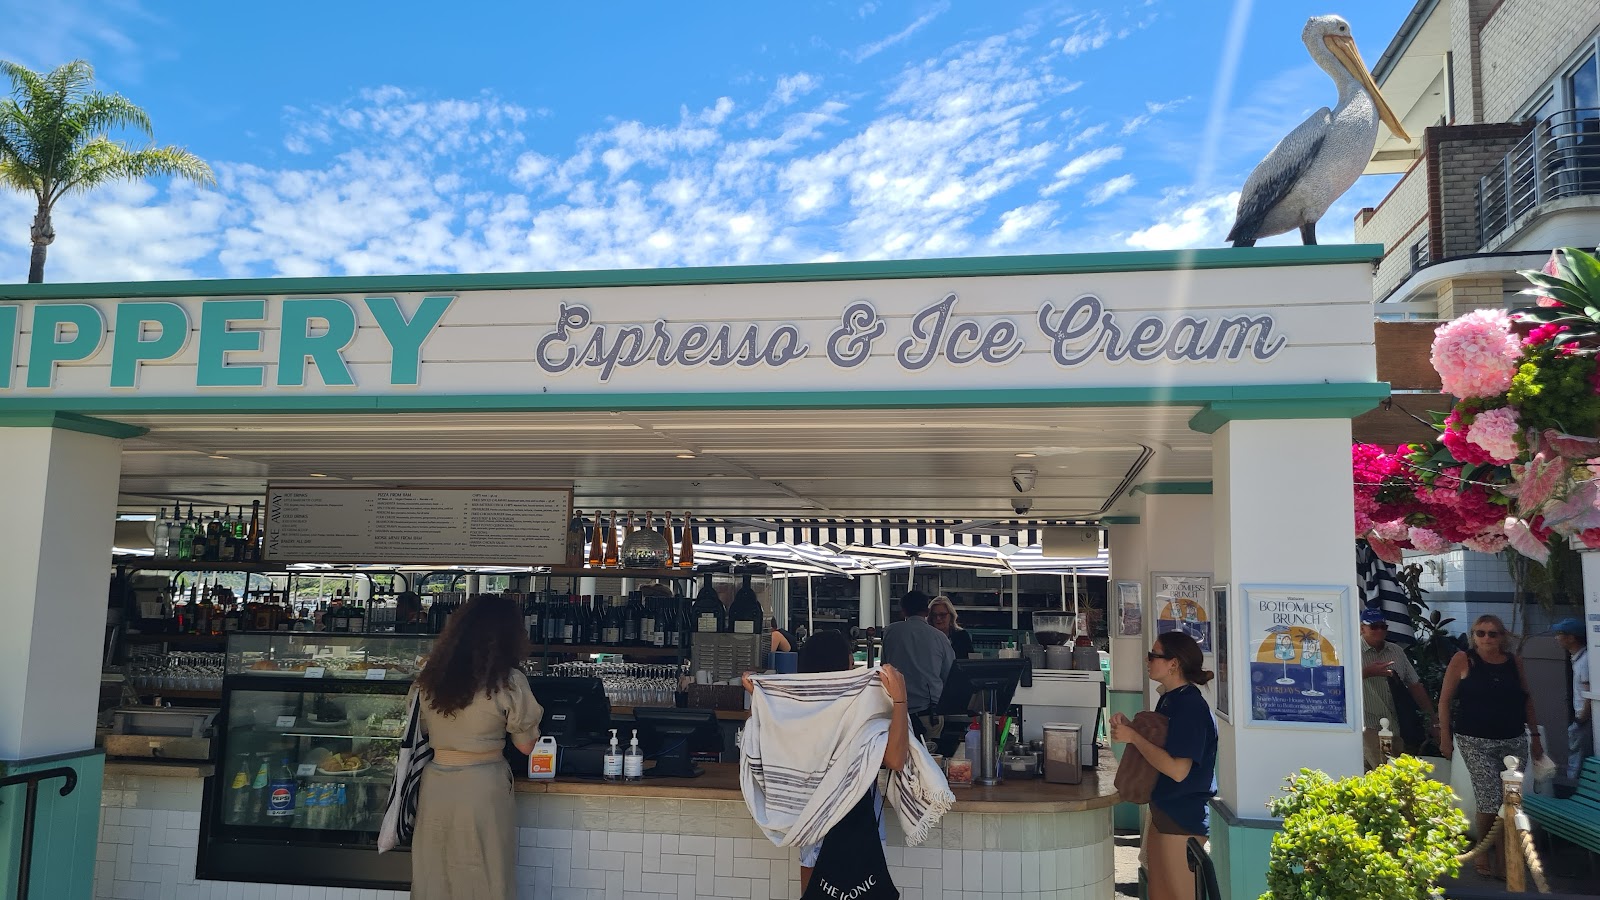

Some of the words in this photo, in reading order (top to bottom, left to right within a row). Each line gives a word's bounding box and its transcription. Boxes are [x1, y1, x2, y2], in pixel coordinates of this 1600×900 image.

[536, 301, 809, 382] Espresso
[825, 300, 884, 370] &
[895, 292, 1022, 373] Ice
[1037, 293, 1286, 370] Cream
[271, 493, 282, 523] AWAY
[268, 529, 280, 557] TAKE
[1259, 601, 1333, 613] BOTTOMLESS
[1273, 613, 1320, 625] BRUNCH
[1255, 686, 1300, 694] SATURDAYS
[819, 878, 840, 898] THE
[840, 874, 876, 900] ICONIC
